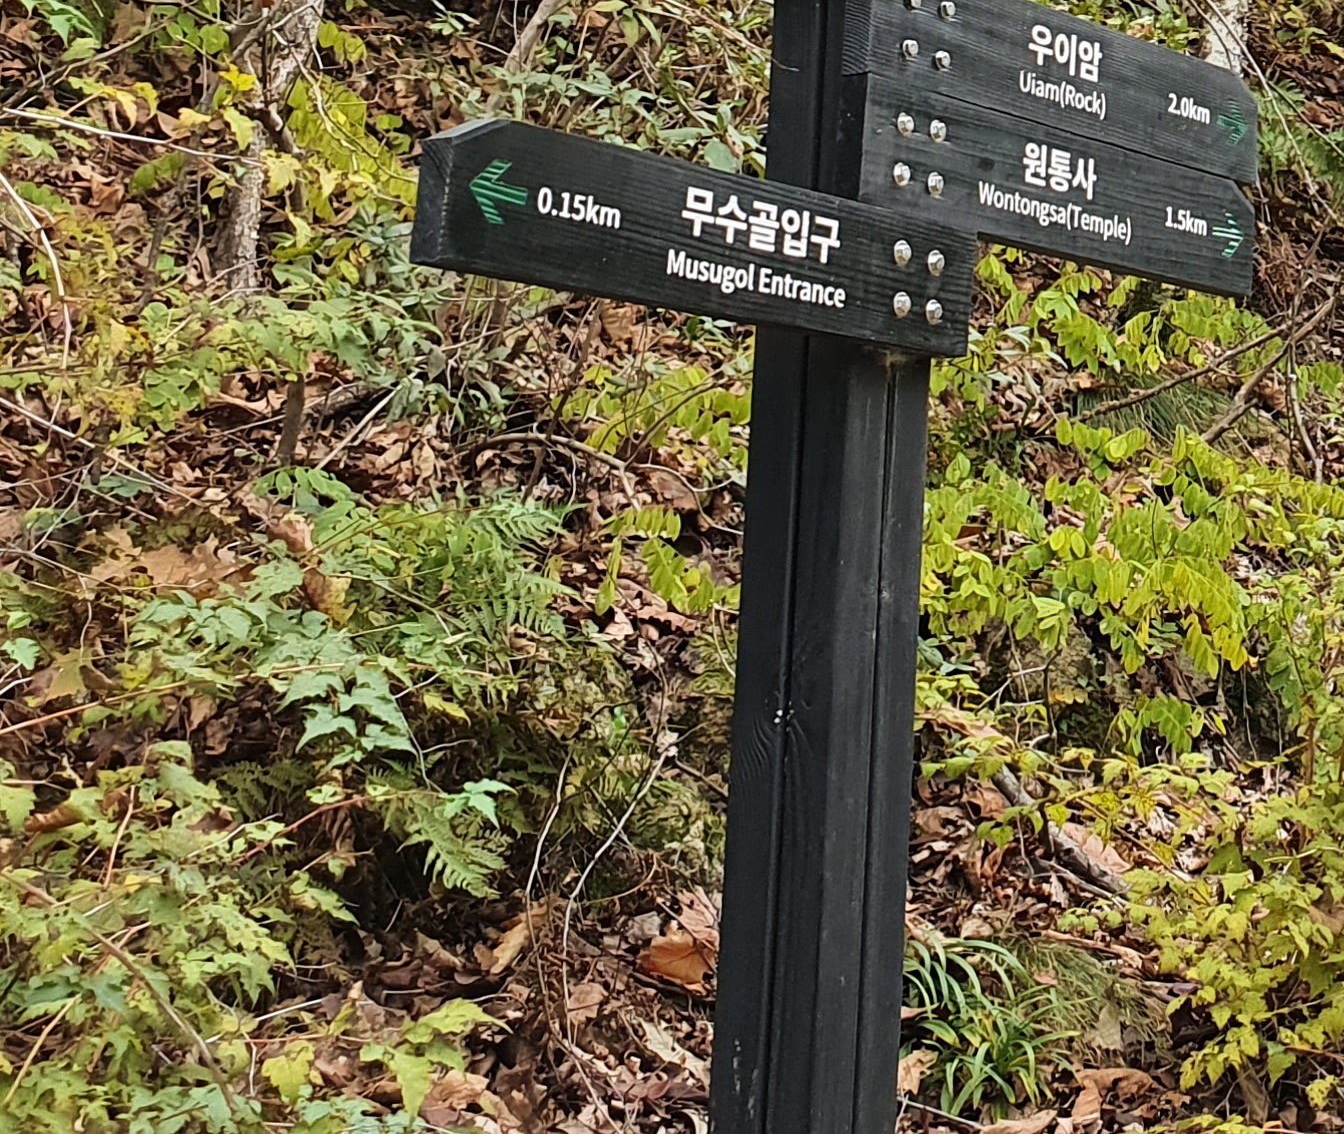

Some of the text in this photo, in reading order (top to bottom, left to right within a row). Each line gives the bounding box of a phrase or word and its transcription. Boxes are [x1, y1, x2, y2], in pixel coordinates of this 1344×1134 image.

[1028, 24, 1103, 83] 우이암
[1018, 69, 1107, 121] Uiam(Rock)
[1167, 92, 1211, 125] 2.0km
[1022, 141, 1098, 201] 원통사
[537, 186, 622, 230] 0.15km
[680, 186, 842, 265] 무수골입구
[978, 180, 1133, 246] Wontongsa(Temple)
[1164, 205, 1208, 237] 1.5km
[666, 247, 846, 309] Musugol Entrance
